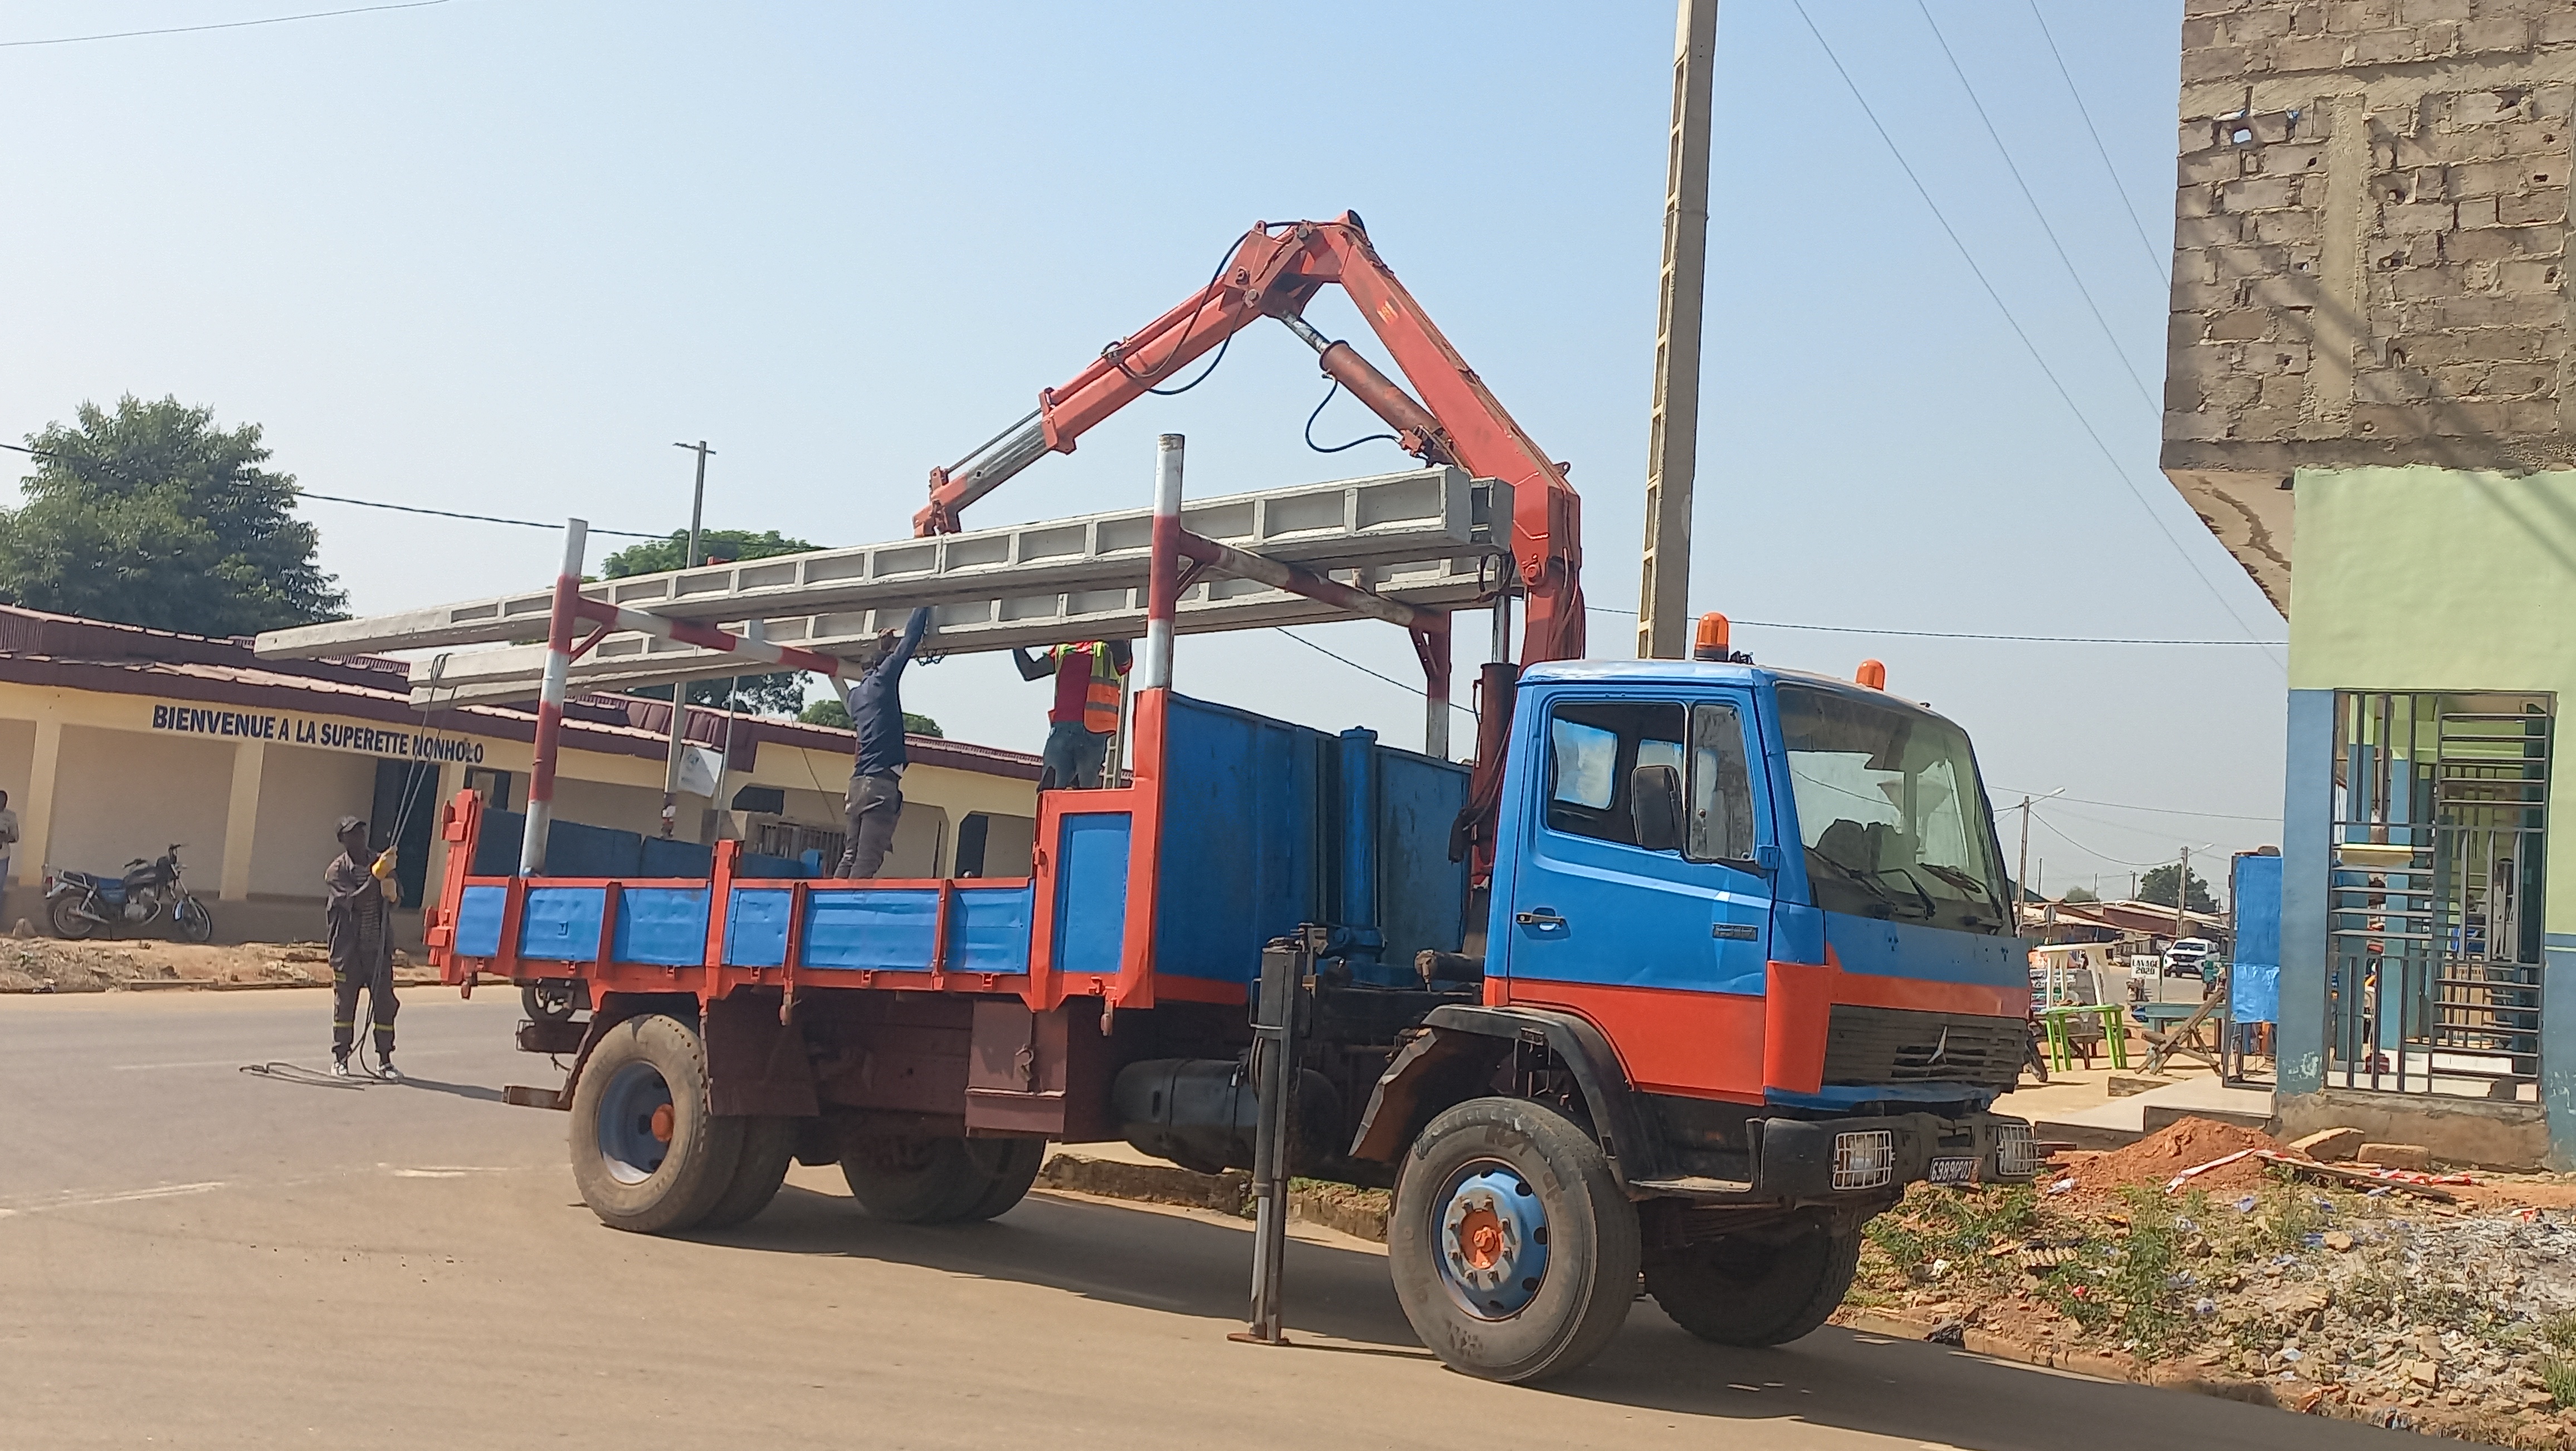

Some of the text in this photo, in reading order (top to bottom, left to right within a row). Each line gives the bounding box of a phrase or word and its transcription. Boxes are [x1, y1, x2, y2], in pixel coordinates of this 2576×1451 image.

[152, 704, 276, 739] BIENVENUE
[277, 718, 289, 741] A
[296, 719, 316, 744] LA
[320, 723, 409, 756] SUPERETTE
[2132, 959, 2159, 968] LAVAGE
